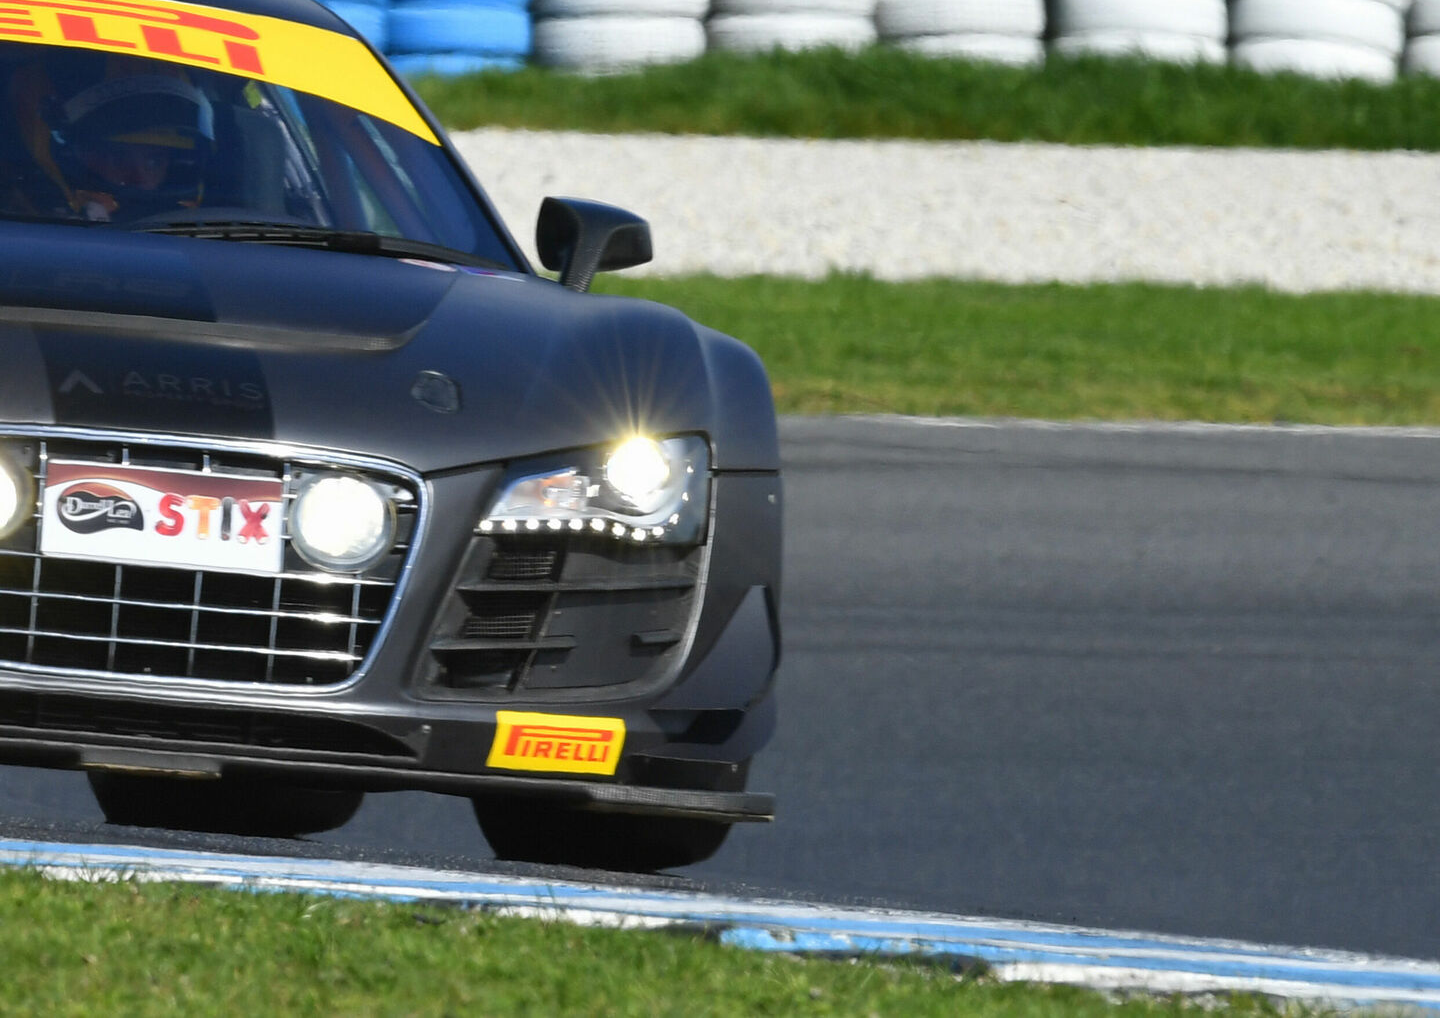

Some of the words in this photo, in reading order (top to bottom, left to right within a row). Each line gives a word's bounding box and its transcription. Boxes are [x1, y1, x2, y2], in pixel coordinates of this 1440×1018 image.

[122, 370, 264, 400] ARRIS
[154, 491, 271, 546] STIX
[504, 724, 614, 764] PIRELLI
